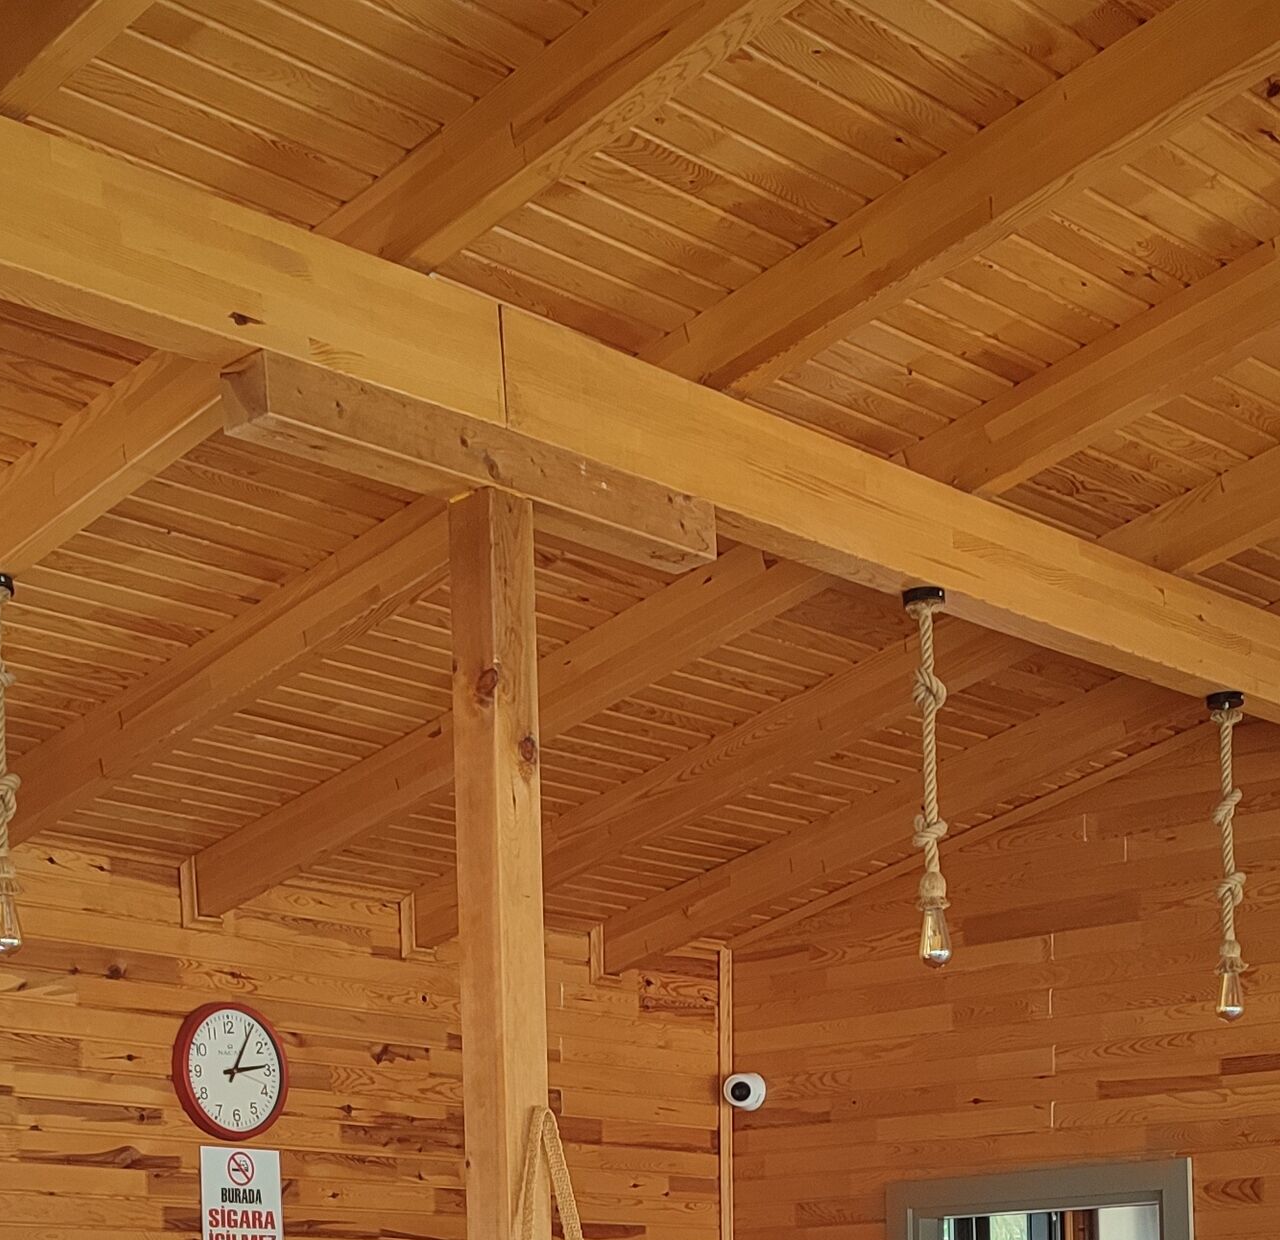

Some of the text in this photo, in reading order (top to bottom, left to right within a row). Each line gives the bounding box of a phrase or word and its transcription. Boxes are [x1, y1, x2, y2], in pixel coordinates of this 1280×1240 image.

[208, 1027, 216, 1040] 11
[223, 1021, 234, 1034] 12
[195, 1042, 207, 1057] 10
[255, 1041, 264, 1054] 2
[194, 1064, 202, 1078] 9
[263, 1063, 271, 1077] 3
[200, 1086, 208, 1100] 8
[260, 1085, 268, 1097] 4
[215, 1104, 223, 1116] 7
[233, 1109, 241, 1121] 6
[250, 1102, 258, 1115] 5
[221, 1187, 262, 1204] BURADA
[208, 1205, 276, 1229] SİGARA
